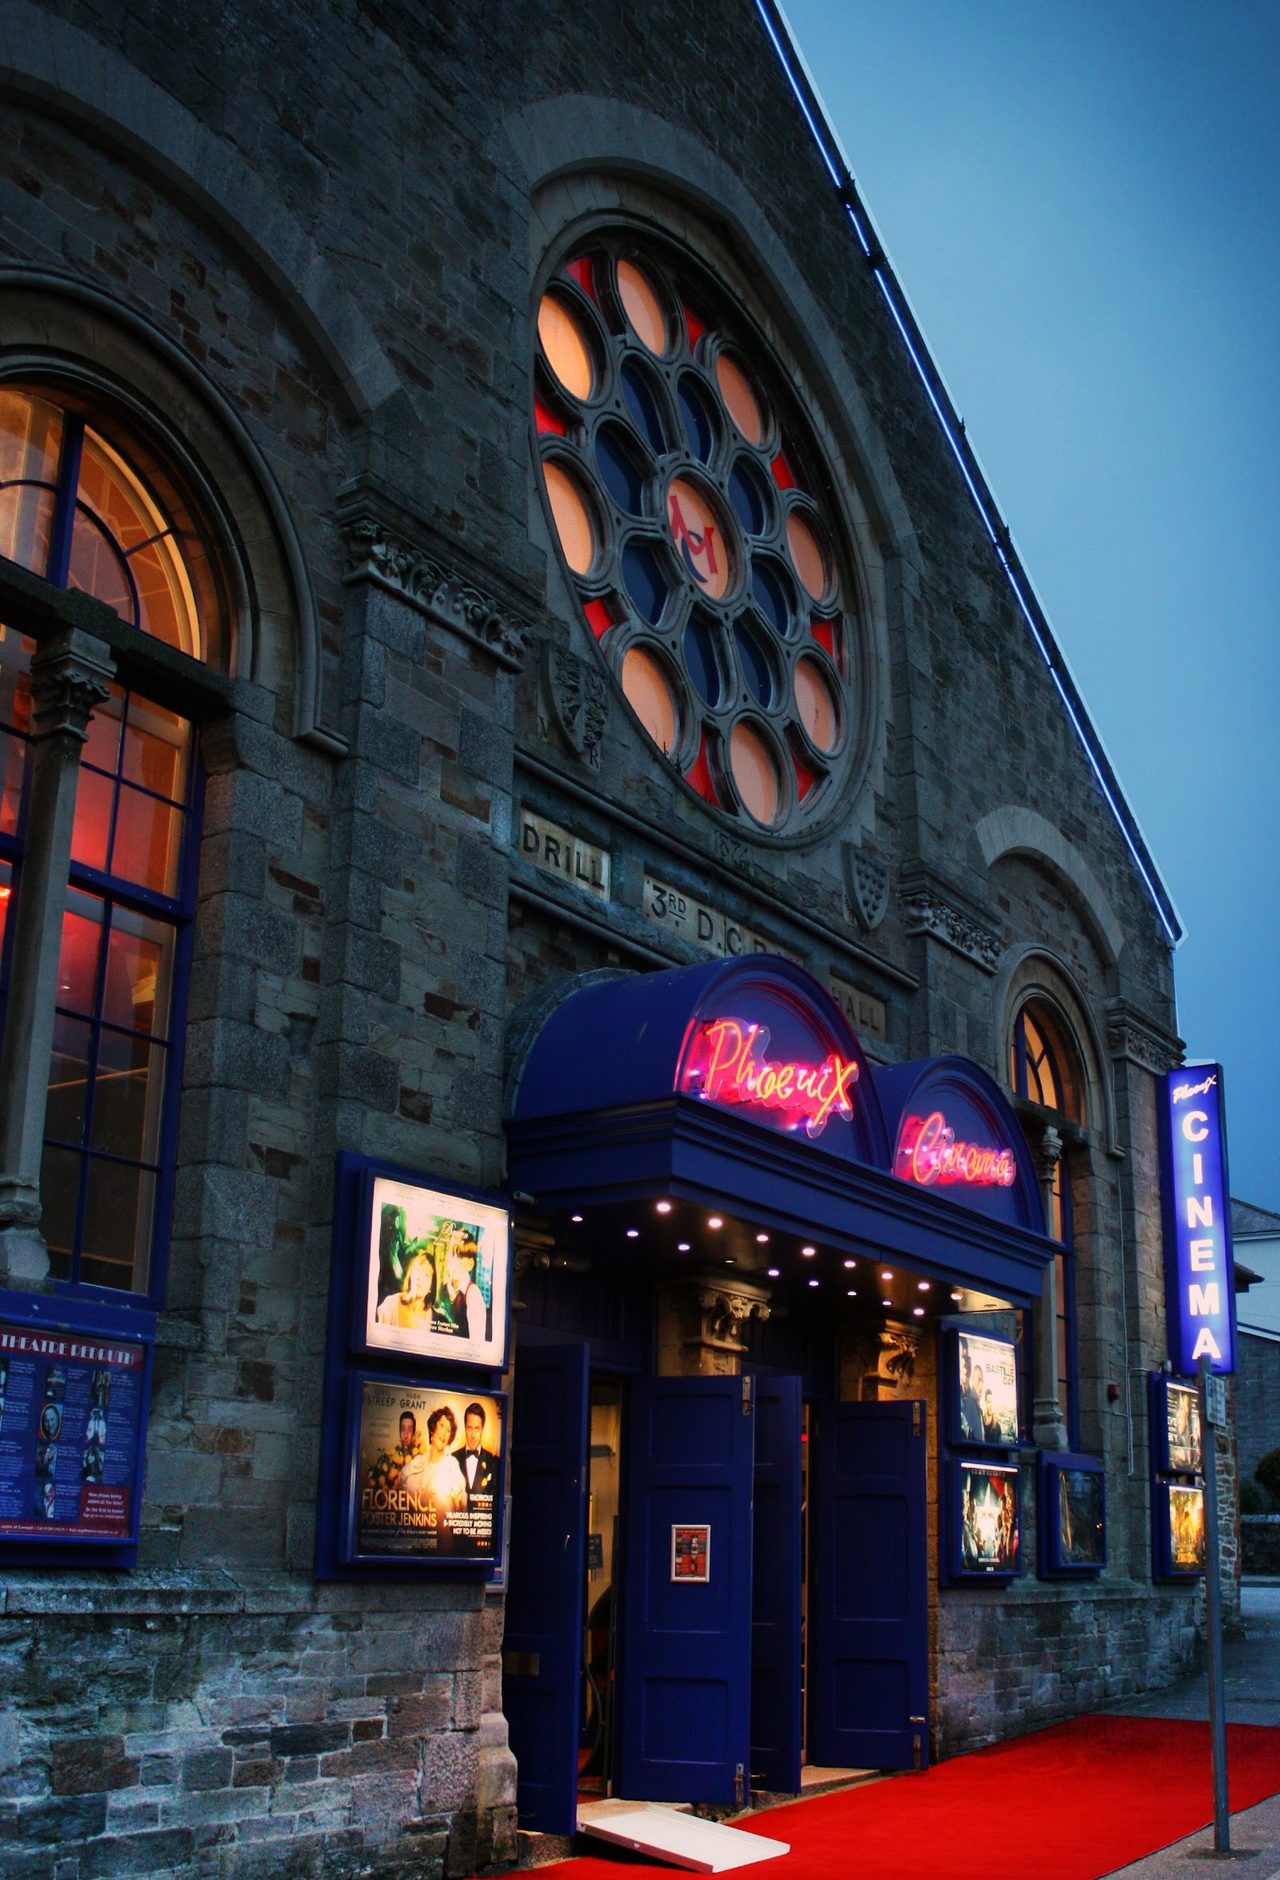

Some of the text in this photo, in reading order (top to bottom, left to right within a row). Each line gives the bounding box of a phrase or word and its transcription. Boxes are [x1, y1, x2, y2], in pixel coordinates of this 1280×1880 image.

[523, 823, 605, 891] DRILL
[832, 986, 880, 1032] HALL
[704, 1020, 858, 1129] Phoenix
[911, 1111, 1012, 1184] Cinema
[1181, 1110, 1222, 1360] CINEMA
[1, 1334, 68, 1356] THEATRE
[368, 1394, 426, 1409] STREEP GRANT
[360, 1511, 437, 1527] FOSTER JENKINS
[361, 1487, 437, 1512] FLORENCE
